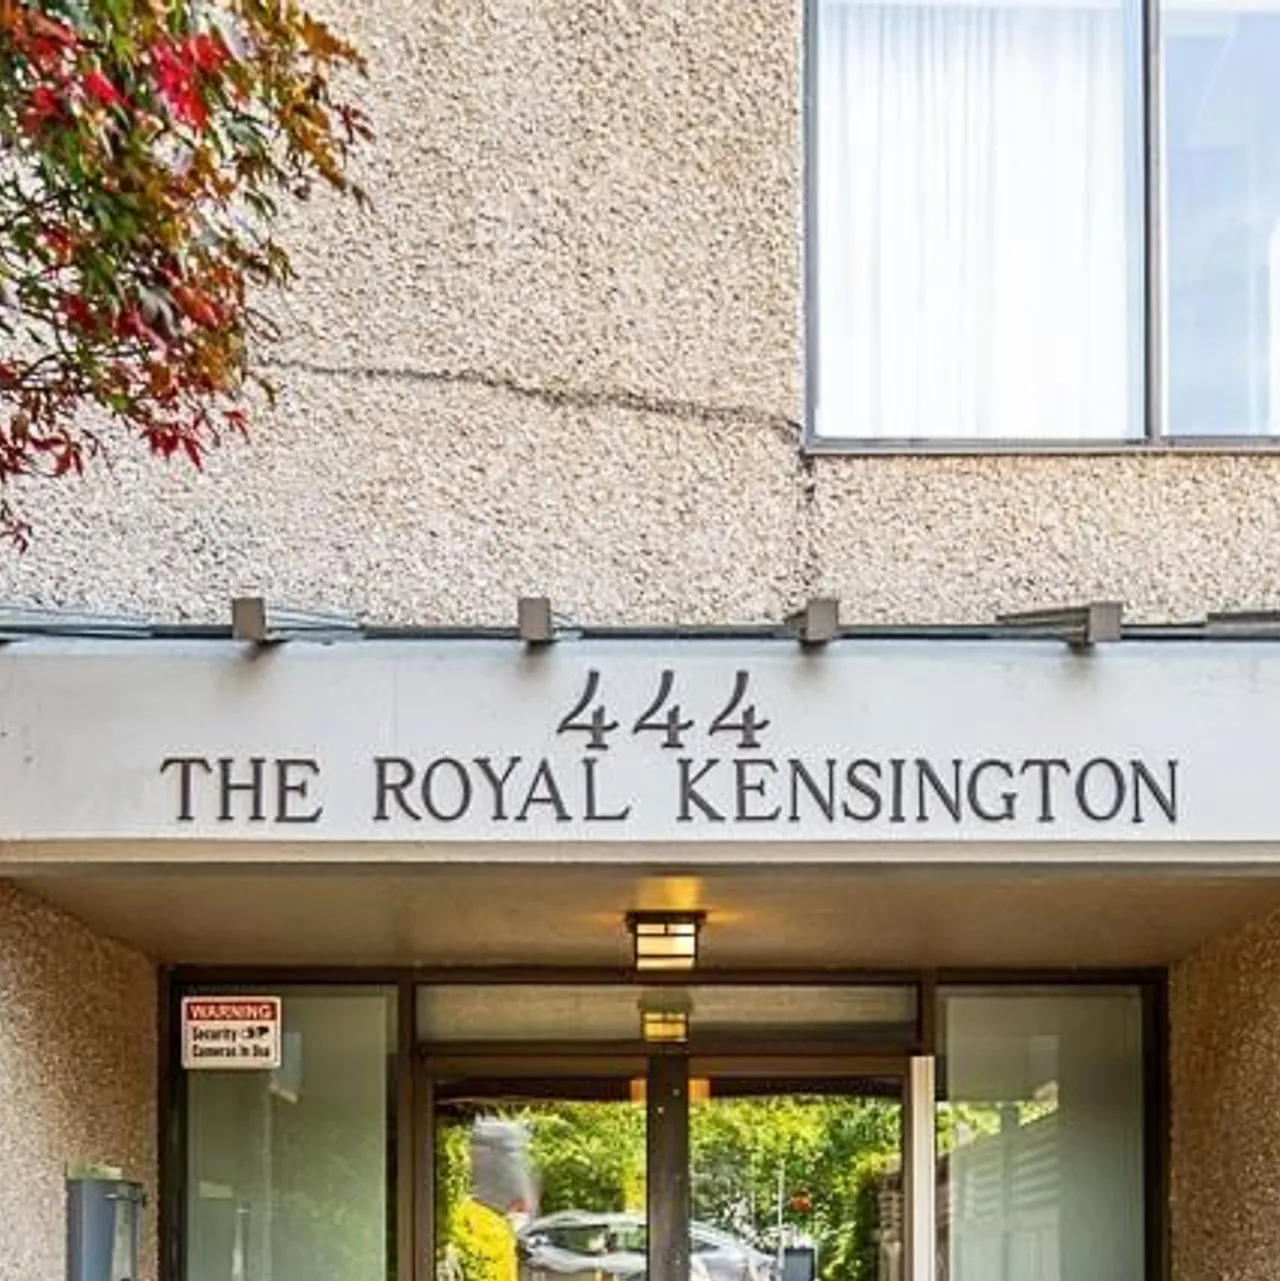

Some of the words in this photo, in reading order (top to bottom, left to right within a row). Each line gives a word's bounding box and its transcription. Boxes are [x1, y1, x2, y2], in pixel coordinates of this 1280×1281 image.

[557, 669, 770, 750] 444
[160, 756, 323, 823] THE
[372, 756, 631, 822] ROYAL
[676, 757, 1180, 823] KENSINGTON
[190, 1004, 272, 1019] WARNING
[193, 1027, 237, 1042] Security
[193, 1044, 236, 1057] Cameras
